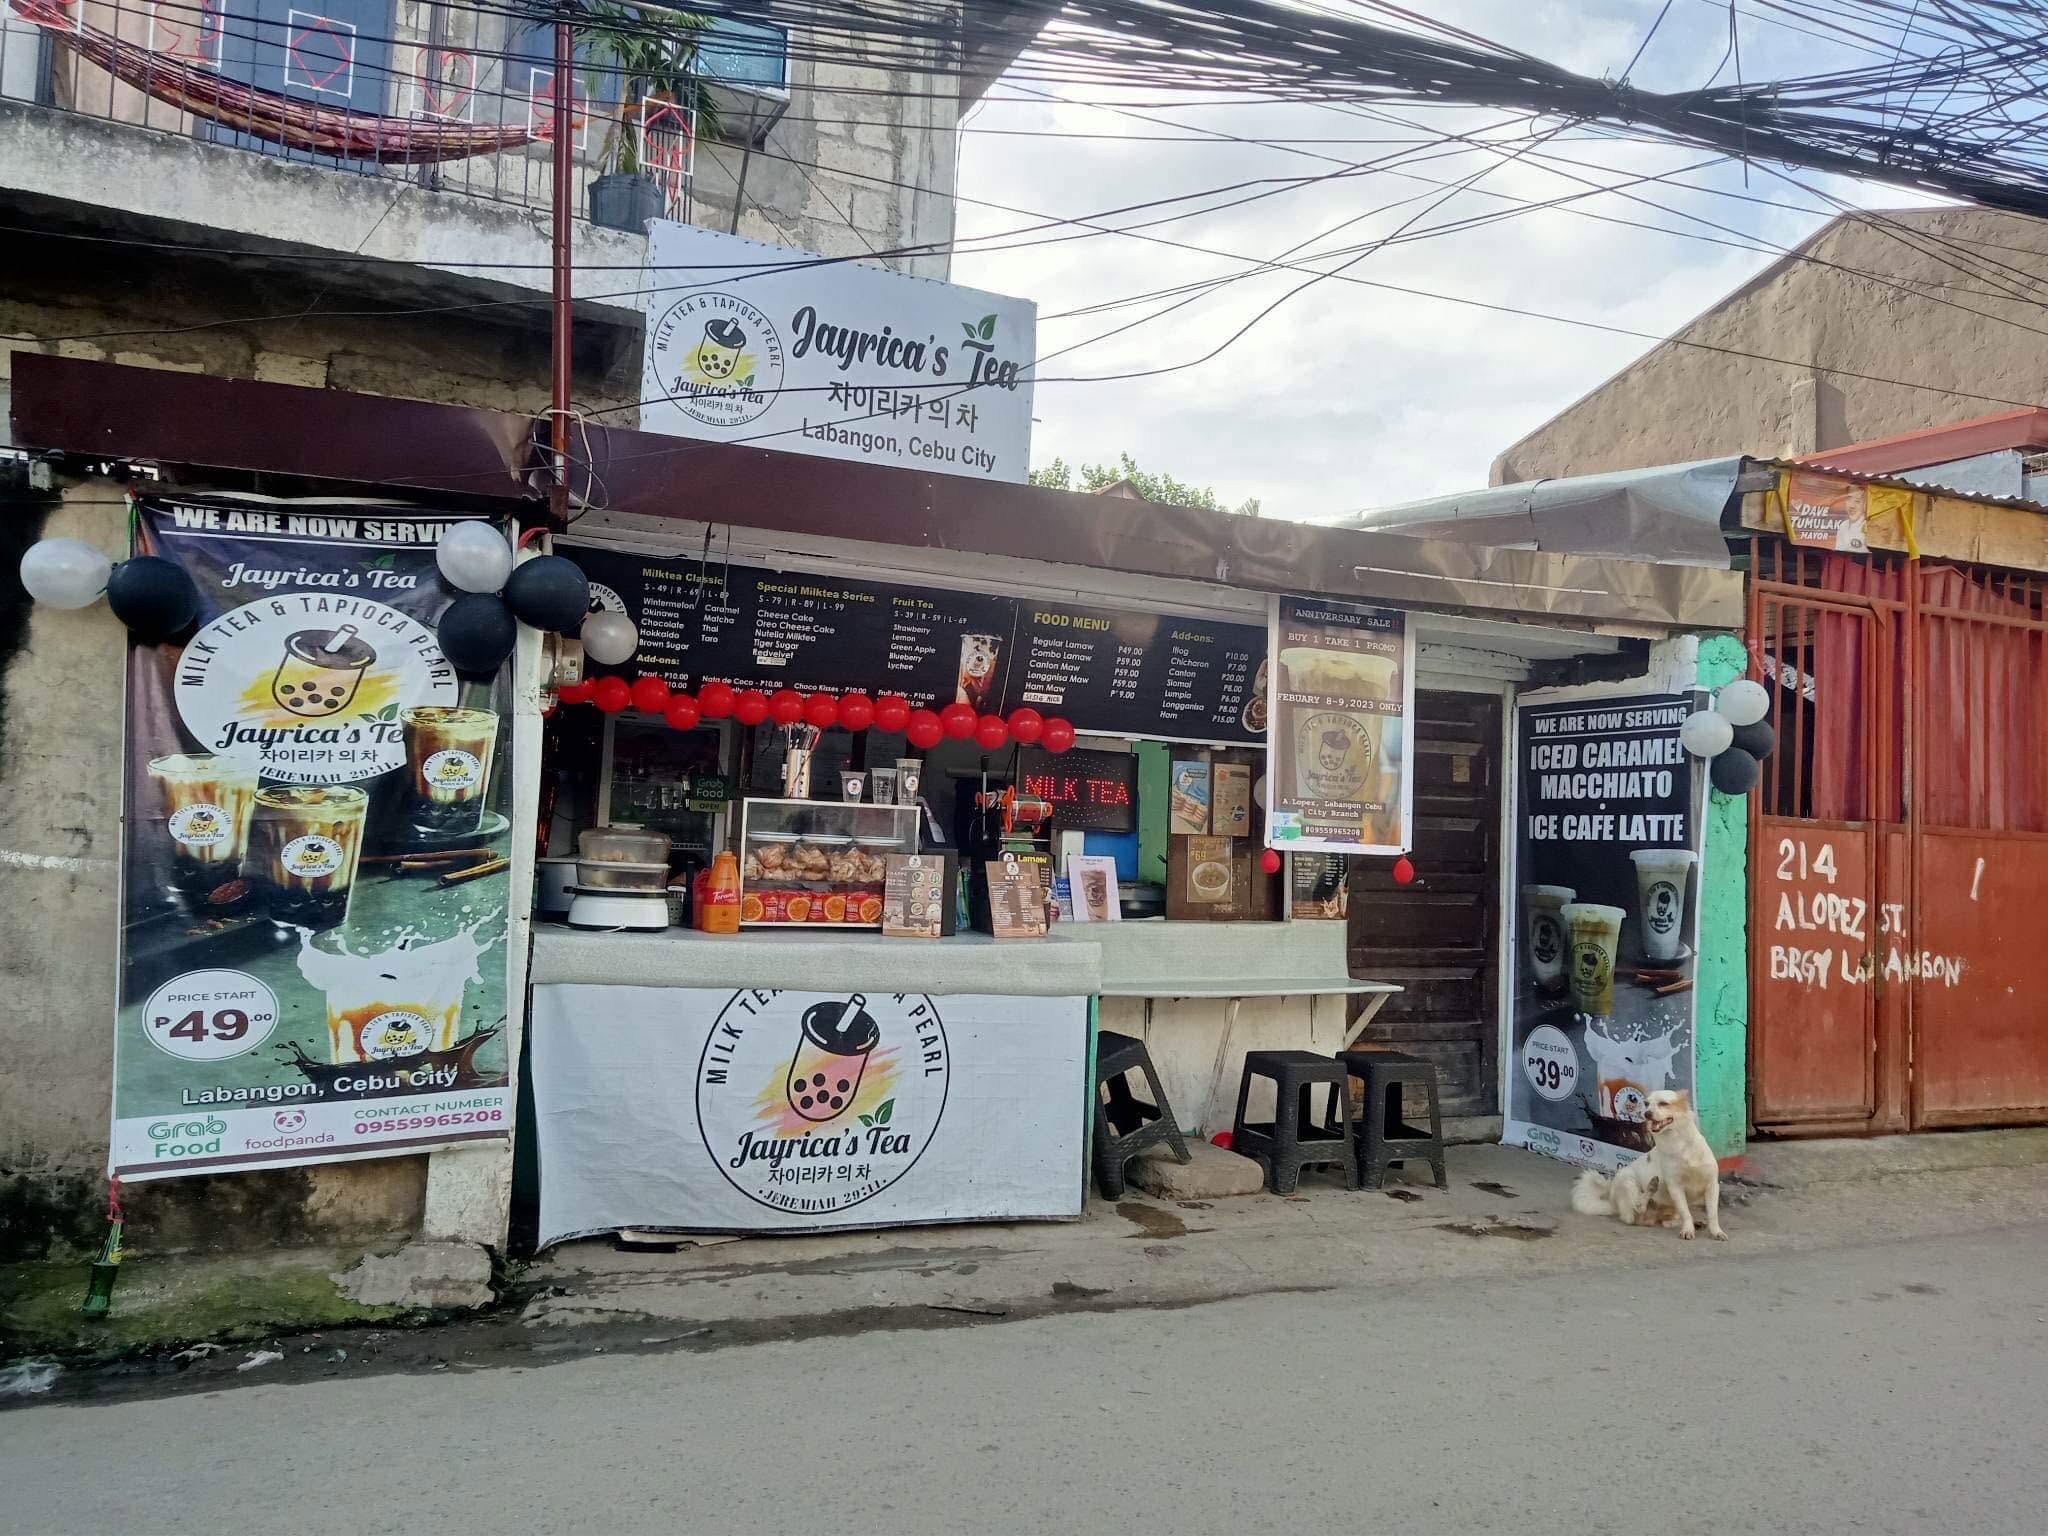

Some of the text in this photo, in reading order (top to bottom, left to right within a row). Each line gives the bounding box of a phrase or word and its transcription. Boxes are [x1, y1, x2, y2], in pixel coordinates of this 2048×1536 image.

[657, 321, 675, 351] MILK
[672, 302, 694, 320] TEA
[712, 297, 762, 327] TAPIOCA
[762, 329, 780, 368] PEARL
[792, 306, 1020, 391] Jayrica's Tea
[671, 376, 763, 404] Jayrica's Tea
[828, 381, 978, 433] 자이리카 의 차
[803, 418, 996, 472] Labangon, Cebu City
[1801, 504, 1829, 516] DAVE
[174, 507, 220, 529] WE
[226, 511, 281, 534] ARE
[289, 515, 357, 538] NOW
[1791, 516, 1843, 530] TUMULAK
[1801, 531, 1829, 540] MAYOR
[222, 562, 417, 589] Jayrica's Tea
[642, 568, 723, 585] Milktea Classic
[756, 581, 875, 602] Special Milktea Series
[643, 597, 695, 610] Wintermelon
[705, 604, 740, 615] Caramel
[892, 597, 934, 609] Fruit Tea
[642, 608, 679, 618] Okinawa
[703, 614, 735, 624] Matcha
[757, 609, 814, 622] Cheese Cake
[1296, 608, 1391, 628] ANNIVERSARY SALE
[640, 618, 684, 629] Chocolate
[702, 624, 719, 633] Thai
[756, 619, 835, 634] Oreo Cheese Cake
[1034, 613, 1110, 631] FOOD MENU
[639, 628, 680, 639] Hokkaido
[754, 628, 816, 642] Nutella Milktea
[893, 623, 931, 636] Strawberry
[1171, 630, 1214, 643] Add-ons:
[182, 597, 452, 688] MILK TEA & TAPIOCA PEARL
[639, 638, 690, 651] Brown Sugar
[701, 634, 719, 643] Taro
[754, 638, 799, 651] Tiger Sugar
[892, 633, 916, 642] Lemon
[1032, 636, 1094, 651] Regular Lamaw
[1288, 633, 1307, 642] BUY
[1325, 636, 1349, 647] TAKE
[1366, 641, 1396, 653] PROMO
[890, 643, 936, 654] Green Apple
[1031, 648, 1093, 662] Combo Lamaw
[636, 653, 679, 665] Add-ons:
[889, 652, 923, 663] Blueberry
[888, 661, 914, 671] Lychee
[1029, 659, 1081, 672] Canton Maw
[1069, 675, 1090, 684] Maw
[1025, 681, 1066, 693] Ham Maw
[1164, 689, 1192, 700] Lumpia
[1277, 692, 1320, 704] FEBUARY
[1159, 710, 1178, 720] Ham
[1535, 707, 1687, 733] WE ARE NOW SERVING
[215, 721, 405, 749] Jayrica's Te
[260, 749, 378, 763] 자이리카 의 차
[1530, 737, 1685, 770] ICED CARAMEL
[1024, 774, 1129, 804] MILK TEA
[1540, 771, 1673, 800] MACCHIATO
[696, 788, 724, 798] Food
[1307, 809, 1359, 818] City Branch
[1529, 814, 1684, 841] ICE CAFE LATTE
[1776, 838, 1838, 884] 214
[1775, 892, 1796, 931] A
[1798, 890, 1865, 941] LOPEZ
[1770, 945, 1832, 990] BRGY
[168, 991, 257, 1002] PRICE START
[706, 1022, 743, 1084] MILK
[909, 1004, 943, 1077] PEARL
[182, 1069, 458, 1106] Labangon, Cebu City
[354, 1097, 503, 1119] CONTACT NUMBER
[148, 1115, 227, 1140] Grab
[354, 1109, 503, 1135] 09559965208
[155, 1138, 220, 1158] Food
[245, 1132, 334, 1150] foodpanda
[729, 1126, 911, 1168] Jayrica's Tea
[768, 1163, 871, 1185] 자이리카 의 차
